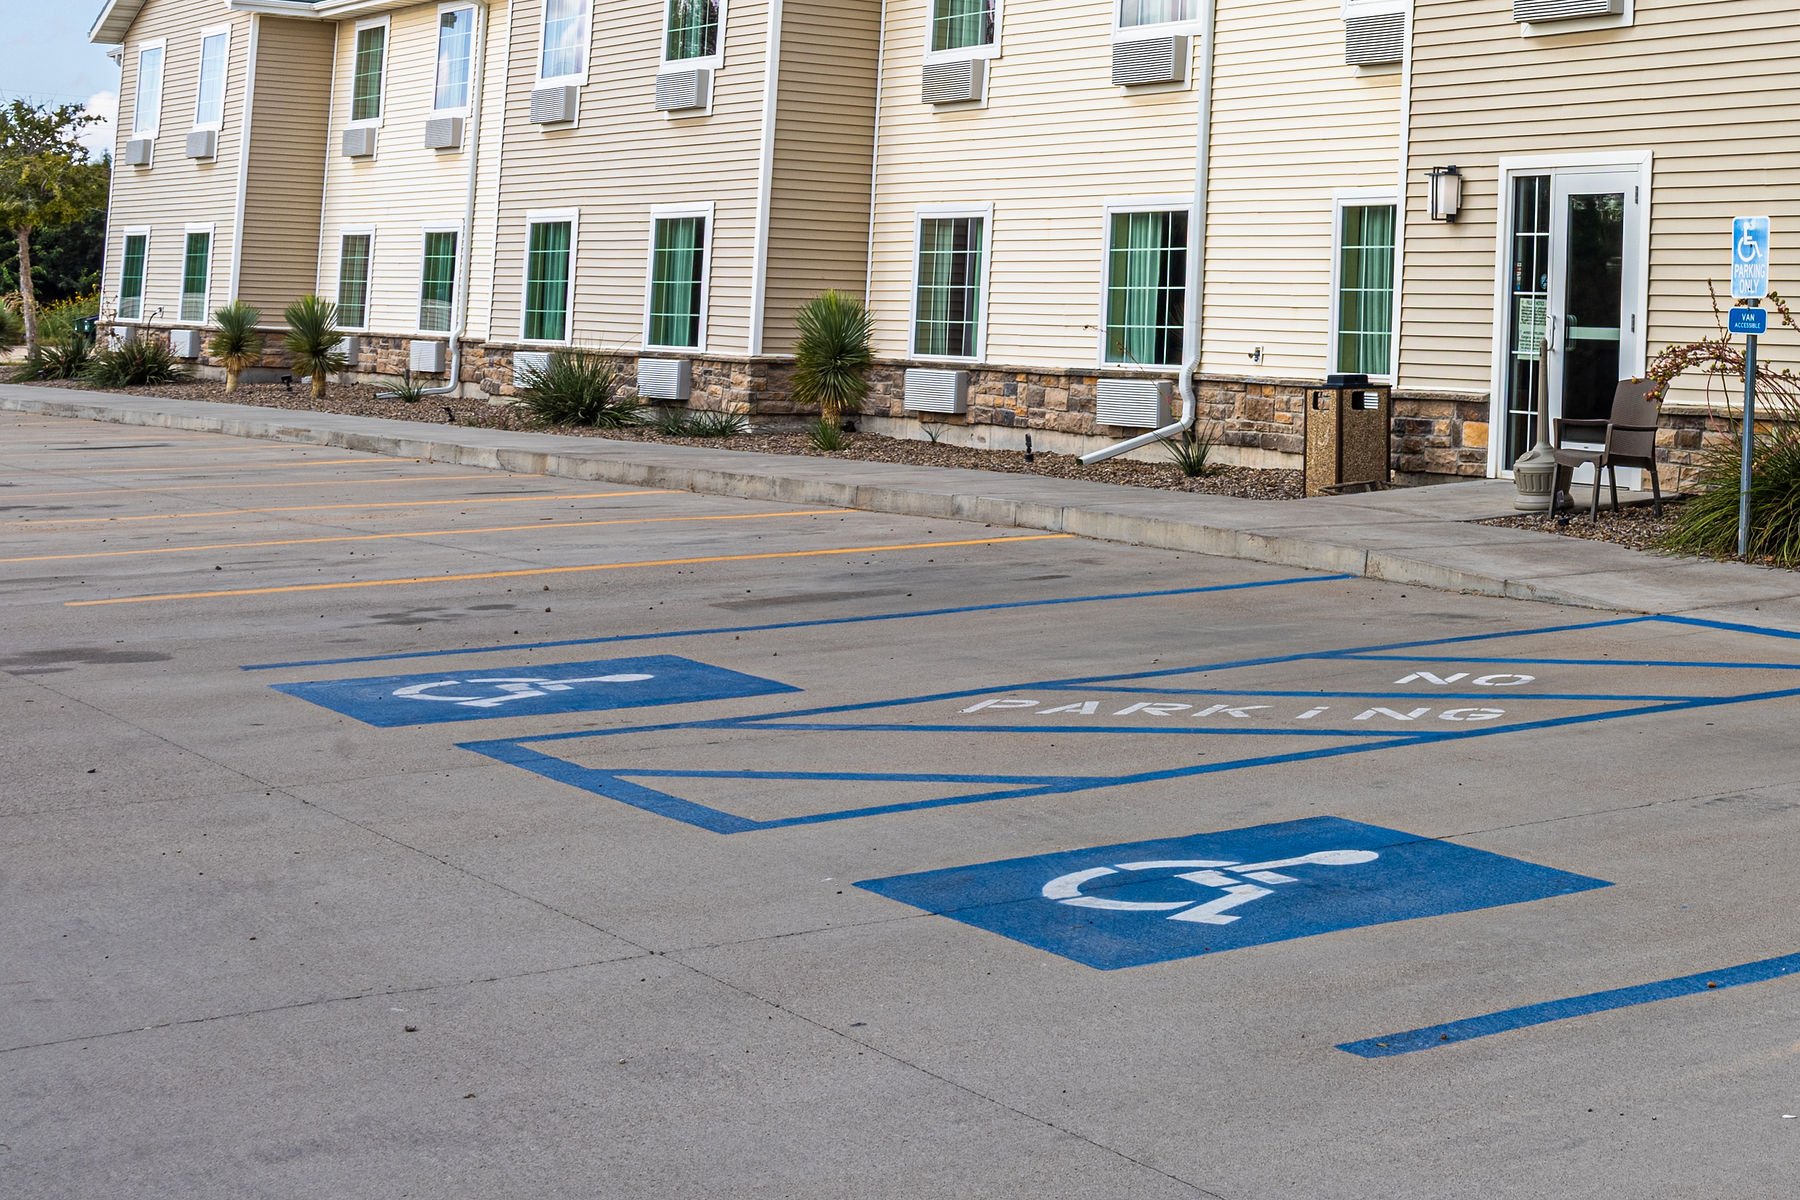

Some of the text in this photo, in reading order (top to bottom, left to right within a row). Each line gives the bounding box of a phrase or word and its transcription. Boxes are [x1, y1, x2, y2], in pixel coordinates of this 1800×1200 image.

[1734, 264, 1766, 278] PARKING
[1740, 279, 1760, 293] ONLY
[1741, 313, 1755, 321] VAN
[1394, 671, 1536, 686] NO
[959, 699, 1507, 722] PARKING
